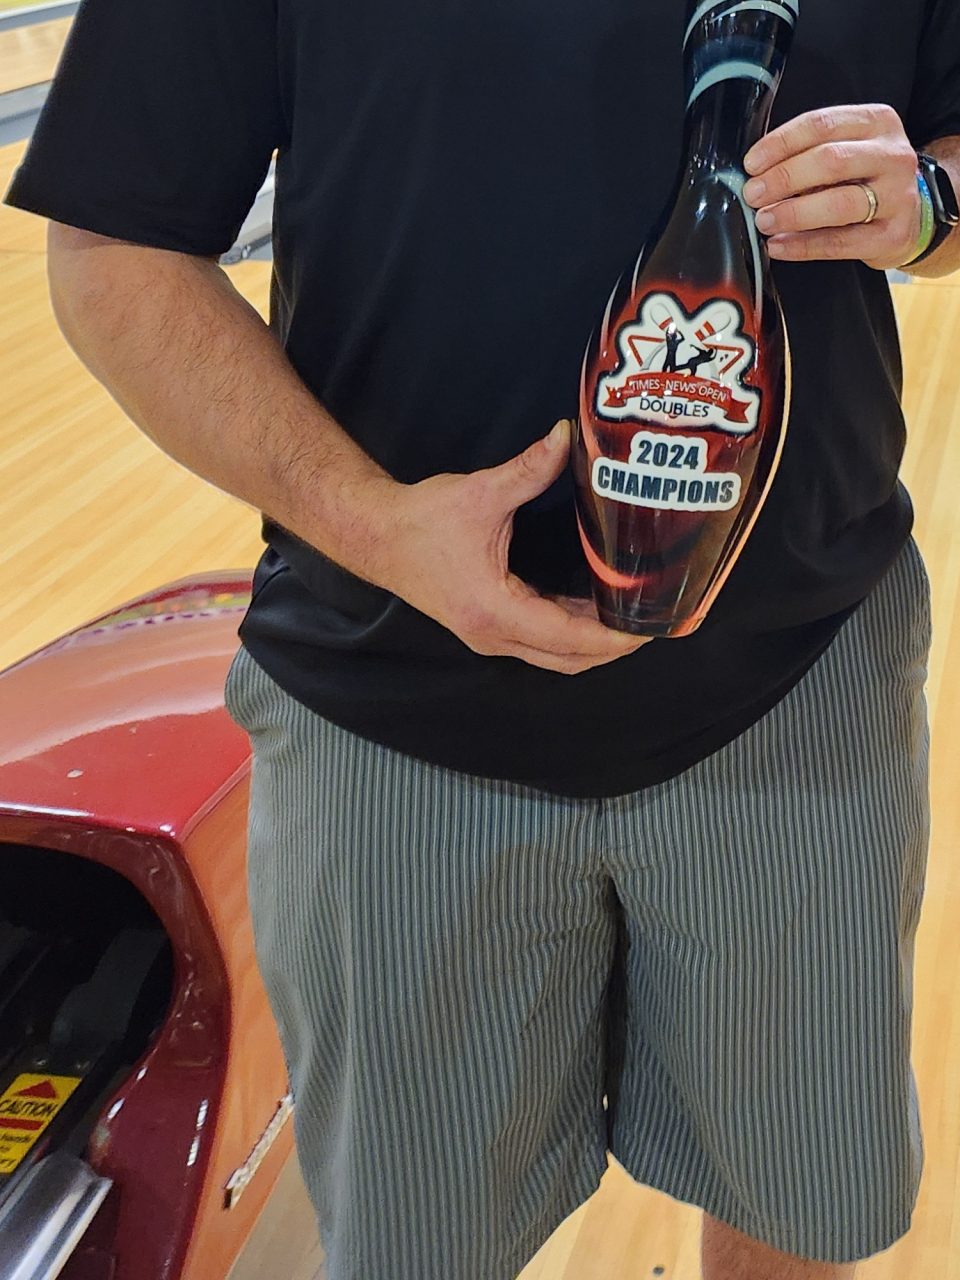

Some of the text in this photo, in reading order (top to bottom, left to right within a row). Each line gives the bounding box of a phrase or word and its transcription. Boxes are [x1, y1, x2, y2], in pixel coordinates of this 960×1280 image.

[698, 385, 727, 403] OPEN
[640, 397, 710, 418] DOUBLES
[636, 439, 700, 470] 2024
[596, 465, 735, 504] CHAMPIONS
